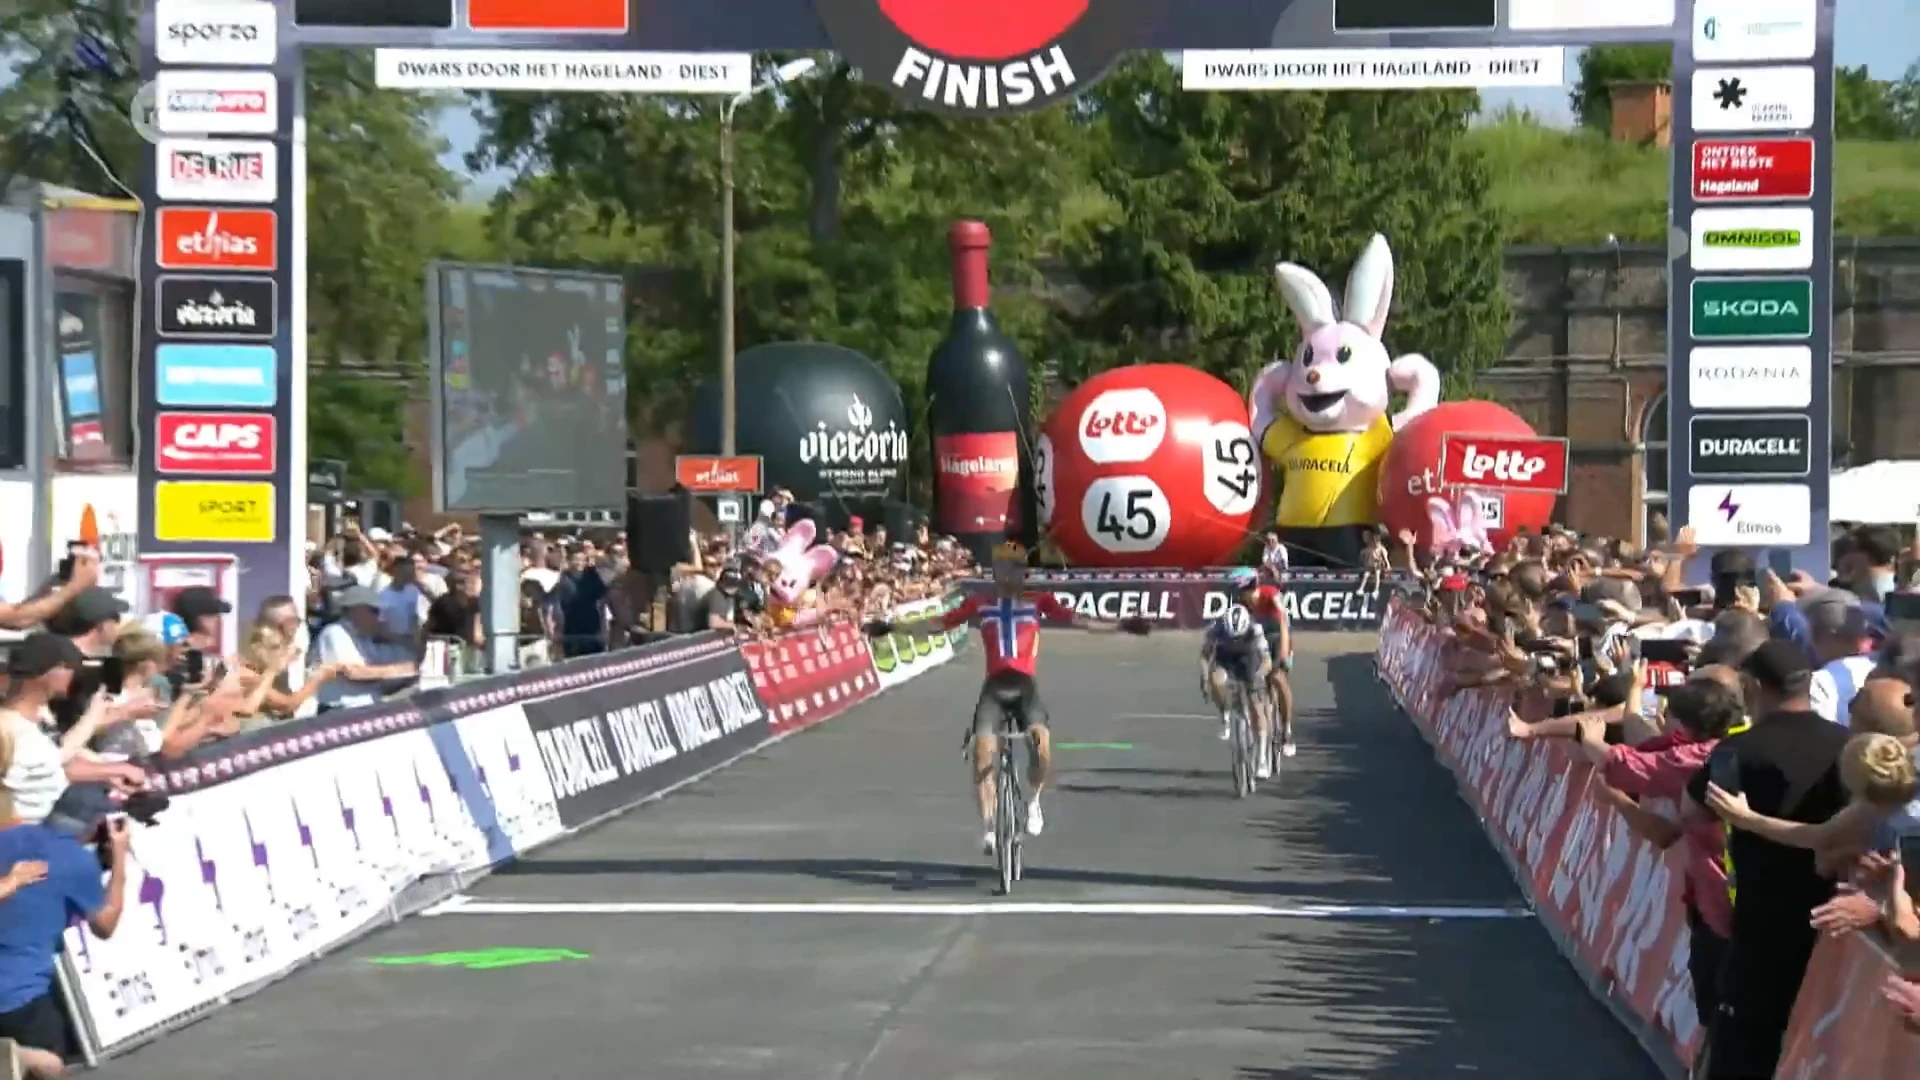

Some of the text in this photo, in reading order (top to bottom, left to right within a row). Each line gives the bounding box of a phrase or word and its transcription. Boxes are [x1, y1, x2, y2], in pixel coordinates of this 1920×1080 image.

[168, 21, 258, 47] sporza
[398, 61, 462, 77] DWARS
[467, 61, 521, 77] DOOR
[526, 62, 560, 78] HET
[565, 63, 663, 79] HAGELAND
[679, 64, 731, 80] DIEST
[891, 45, 1077, 109] FINISH
[1205, 62, 1268, 78] DWARS
[1274, 62, 1327, 77] DOOR
[1333, 61, 1366, 77] HET
[1372, 60, 1471, 76] HAGELAND
[1488, 58, 1541, 75] DIEST
[1701, 145, 1758, 158] ONTDEK
[172, 152, 262, 179] DELRUE
[1700, 178, 1760, 195] Hageland
[1698, 366, 1801, 381] RODANIA
[175, 424, 262, 449] CAPS
[1700, 437, 1801, 456] DURACELL
[1215, 437, 1256, 500] 45
[198, 499, 258, 514] SPORT
[1096, 489, 1157, 542] 45
[1202, 590, 1376, 620] DACELL
